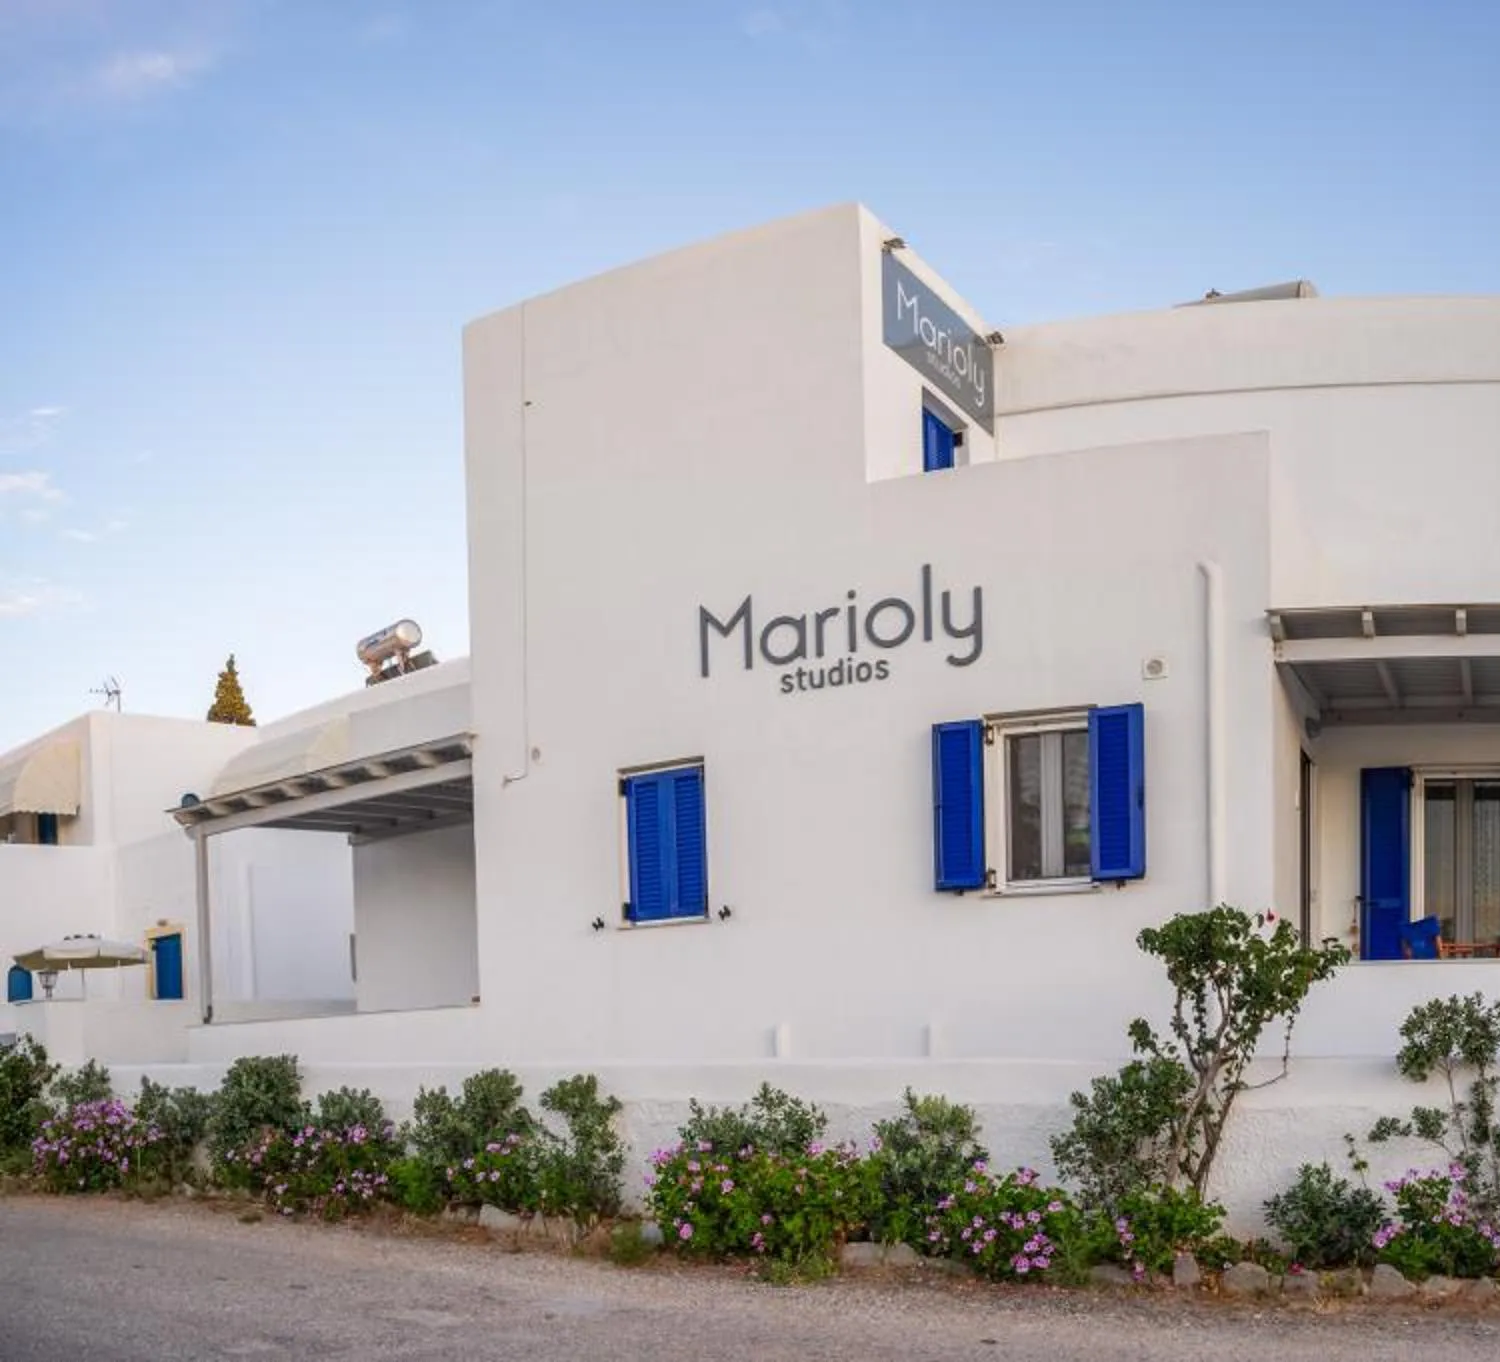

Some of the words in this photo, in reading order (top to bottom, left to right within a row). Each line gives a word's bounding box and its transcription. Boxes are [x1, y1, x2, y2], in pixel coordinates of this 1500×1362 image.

[897, 280, 985, 408] Marioly
[698, 563, 984, 679] Marioly
[779, 656, 890, 694] studios
